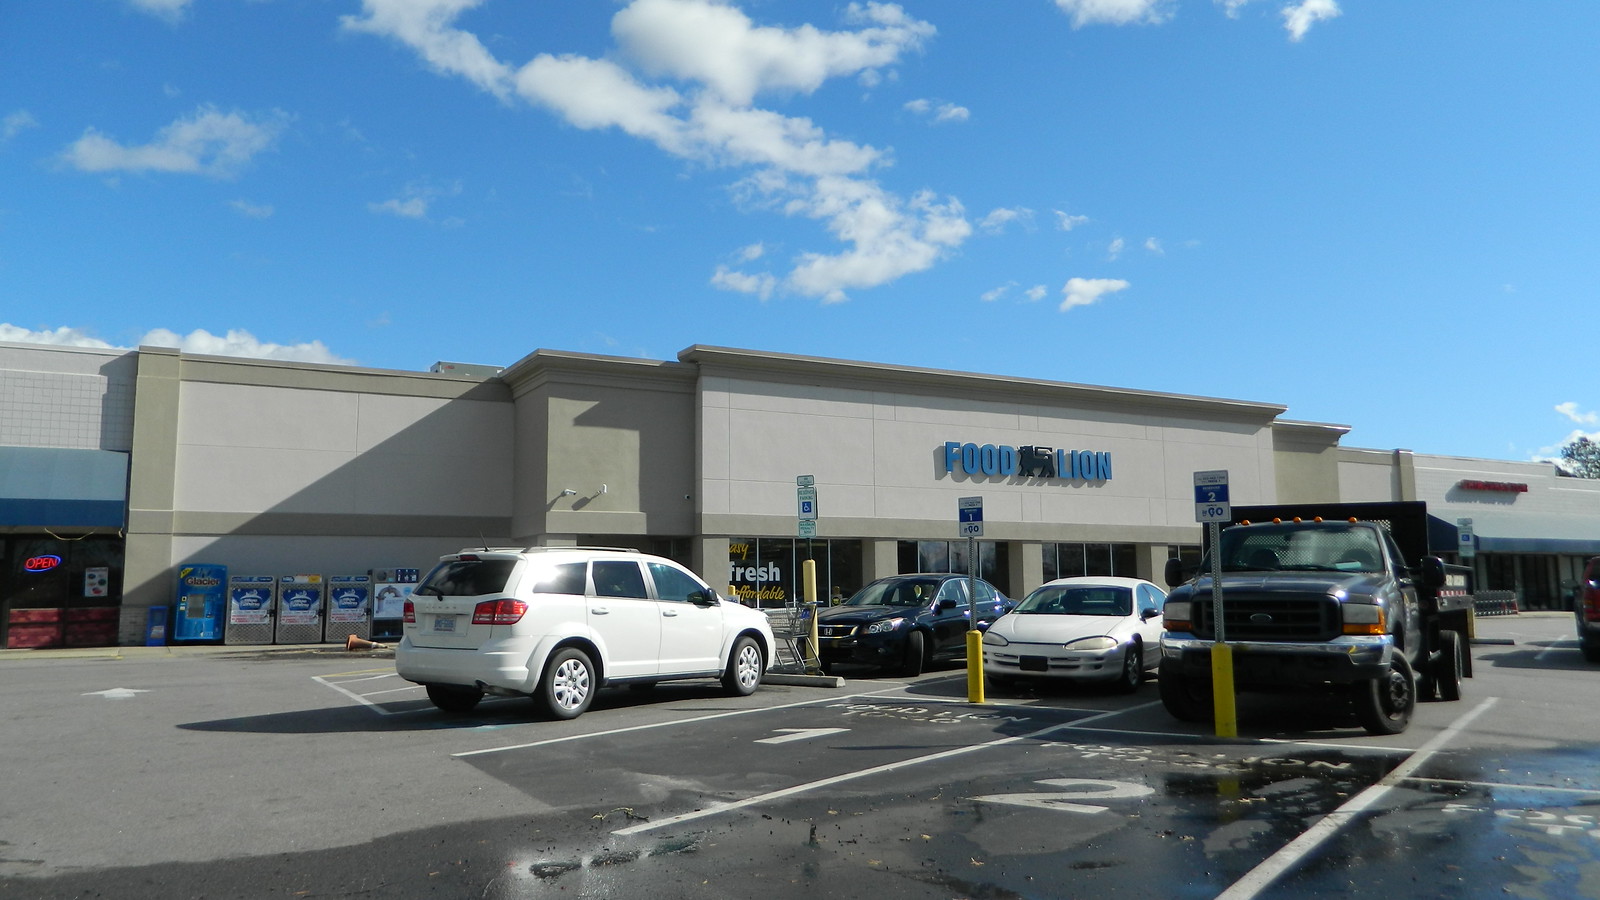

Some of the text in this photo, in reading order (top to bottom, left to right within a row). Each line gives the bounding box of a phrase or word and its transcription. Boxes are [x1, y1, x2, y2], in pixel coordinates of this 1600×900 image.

[943, 441, 1113, 480] FOOD LION
[1207, 491, 1216, 502] 2
[968, 513, 973, 521] 1
[25, 557, 58, 569] OPEN
[729, 561, 781, 581] fresh
[186, 577, 219, 586] Glacier
[752, 727, 851, 744] 1
[970, 778, 1155, 814] 2
